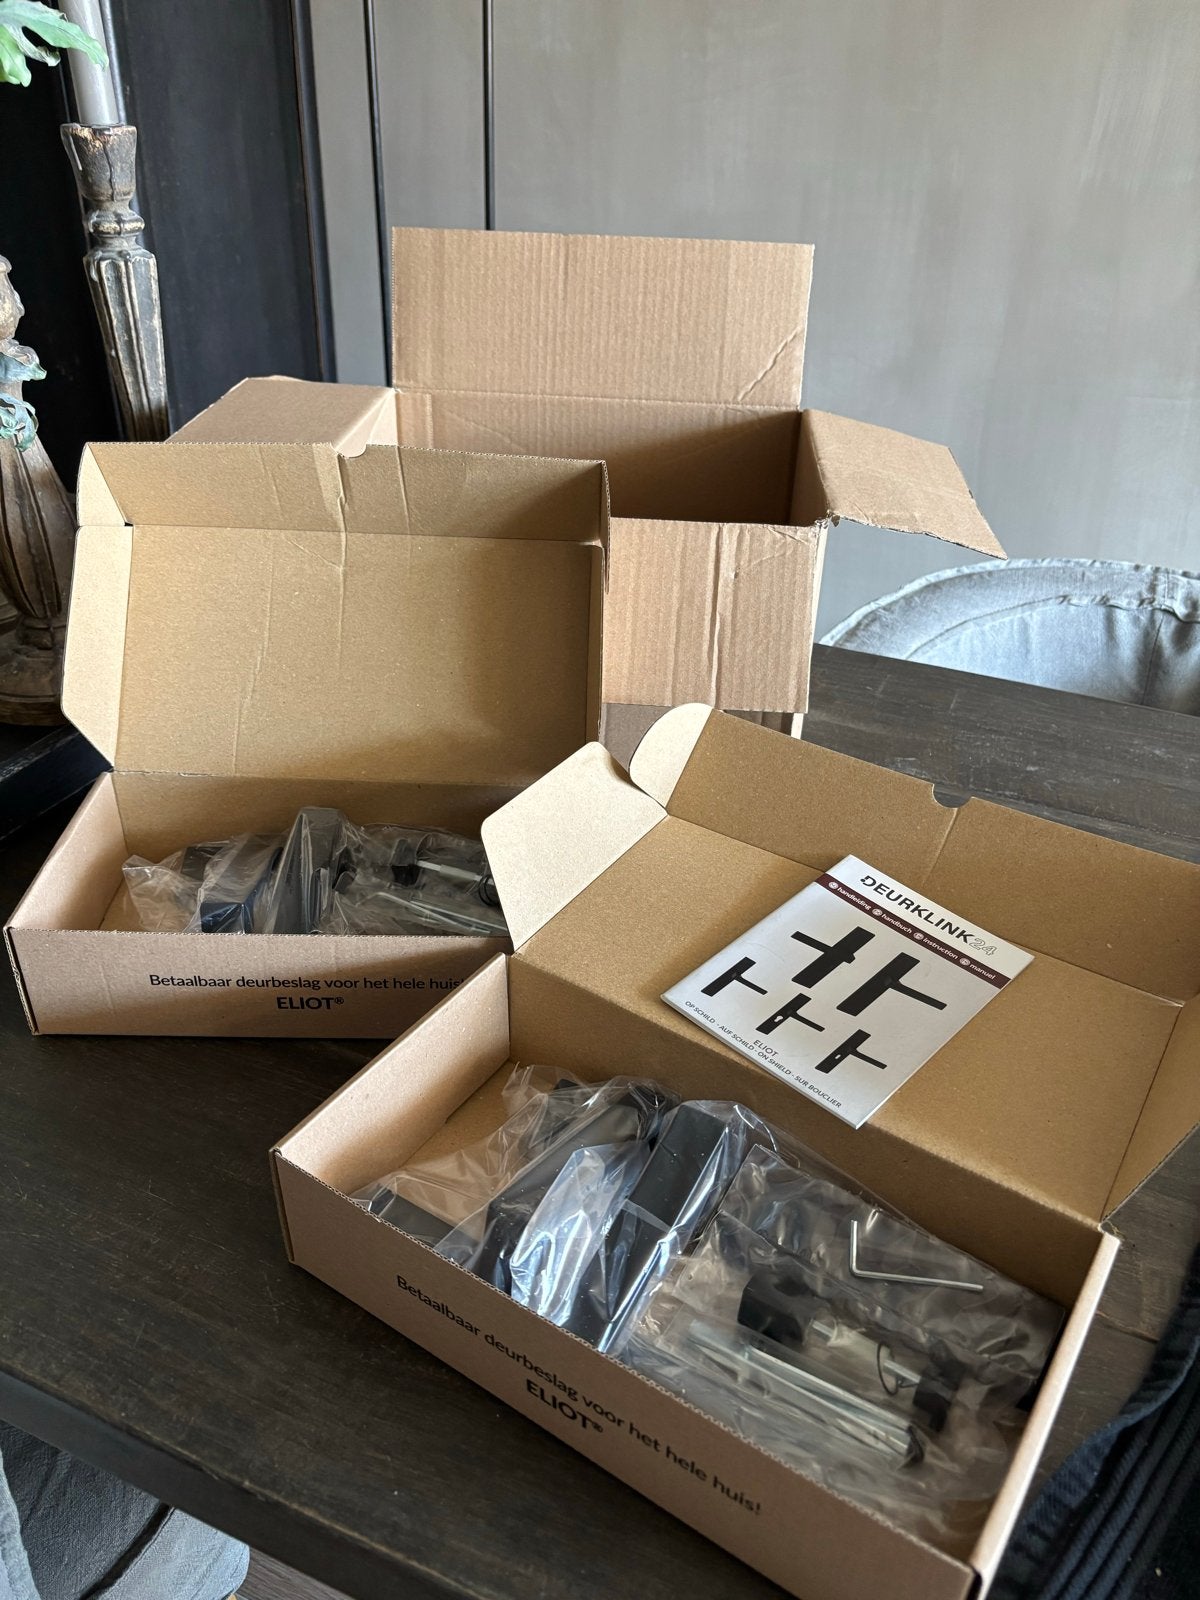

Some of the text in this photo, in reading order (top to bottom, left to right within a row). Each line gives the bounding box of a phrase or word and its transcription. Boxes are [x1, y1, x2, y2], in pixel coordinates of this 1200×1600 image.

[837, 887, 996, 980] handleiding handbuch instruction manuel
[860, 875, 997, 956] DEURKLINK24
[149, 974, 232, 988] Betaalbaar
[236, 976, 321, 991] deurbeslag
[324, 979, 361, 990] voor
[364, 977, 389, 990] het
[392, 977, 426, 990] hele
[685, 1001, 696, 1009] OP
[693, 1006, 716, 1024] SCHILD
[719, 1025, 733, 1034] AUF
[731, 1033, 755, 1051] SCHILD
[757, 1051, 769, 1061] ON
[767, 1057, 792, 1075] SHIELD
[794, 1075, 809, 1087] SUR
[807, 1084, 842, 1108] BOUCLIER
[753, 1039, 779, 1057] ELIOT
[396, 1275, 762, 1516] Betaalbaar deurbeslag voor het hele huis!
